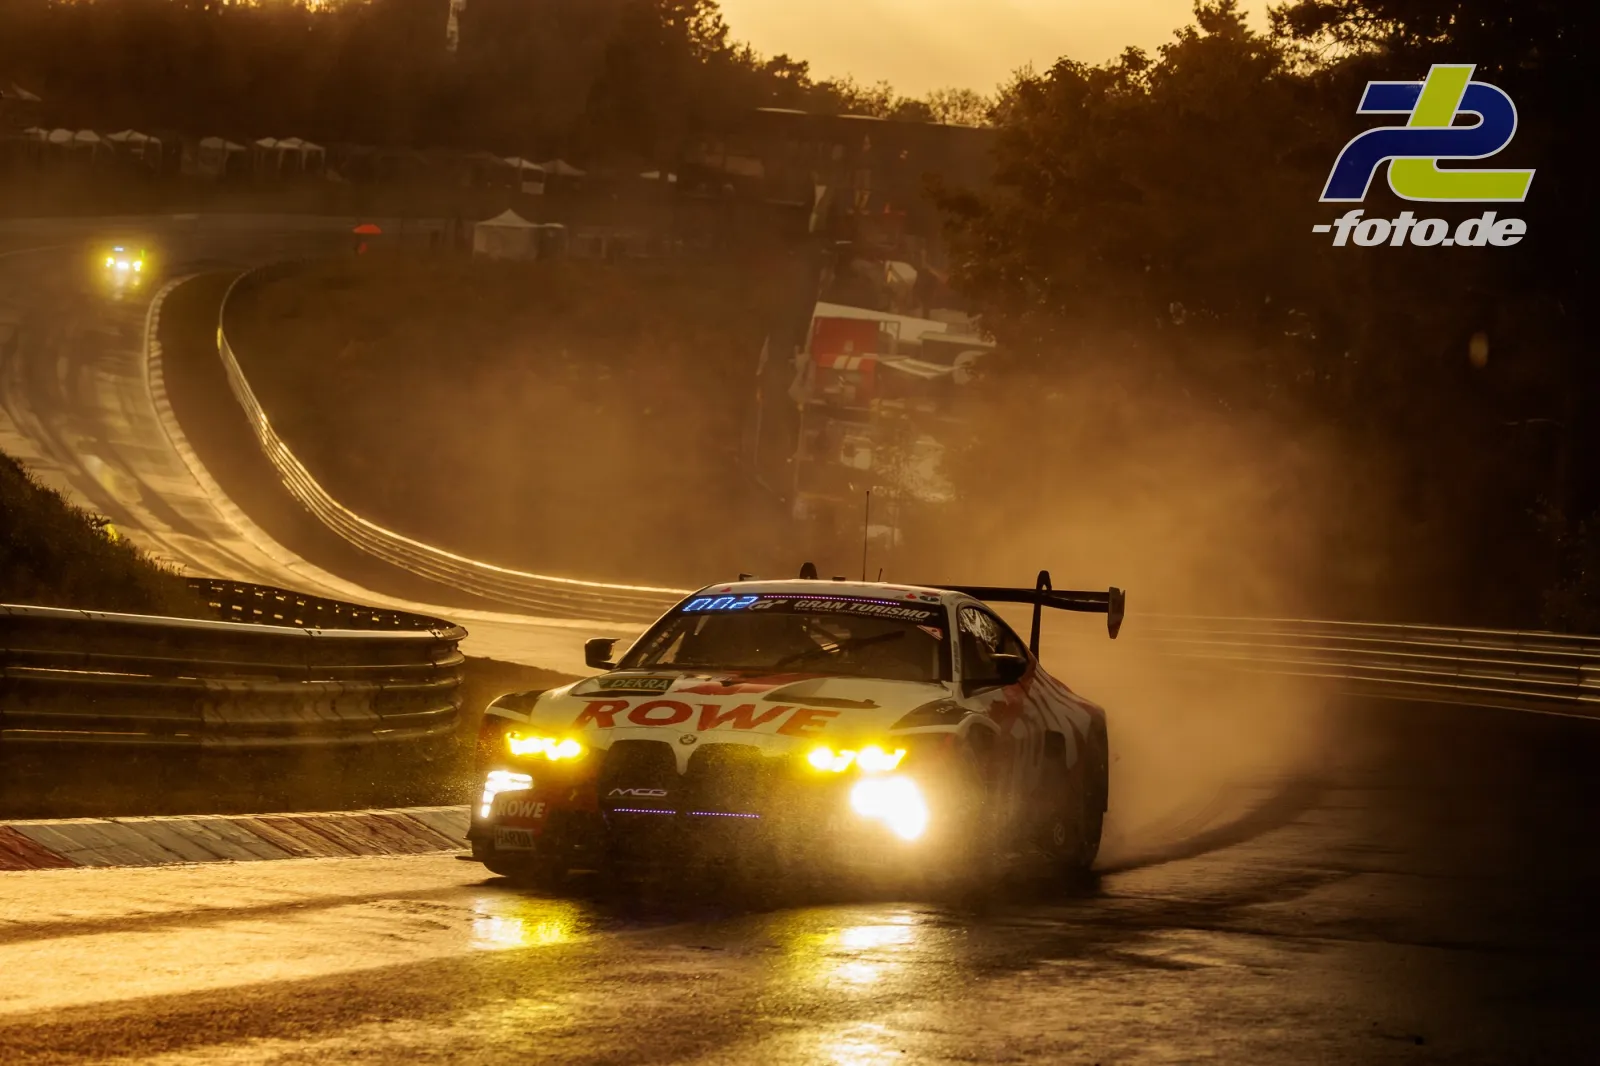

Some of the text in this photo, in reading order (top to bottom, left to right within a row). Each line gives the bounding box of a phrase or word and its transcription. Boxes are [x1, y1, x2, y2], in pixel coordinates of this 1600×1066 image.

[682, 596, 759, 612] 002
[794, 600, 848, 610] GRAN
[609, 679, 670, 690] DEKRA
[570, 699, 842, 736] ROWE
[496, 800, 546, 819] ROWE
